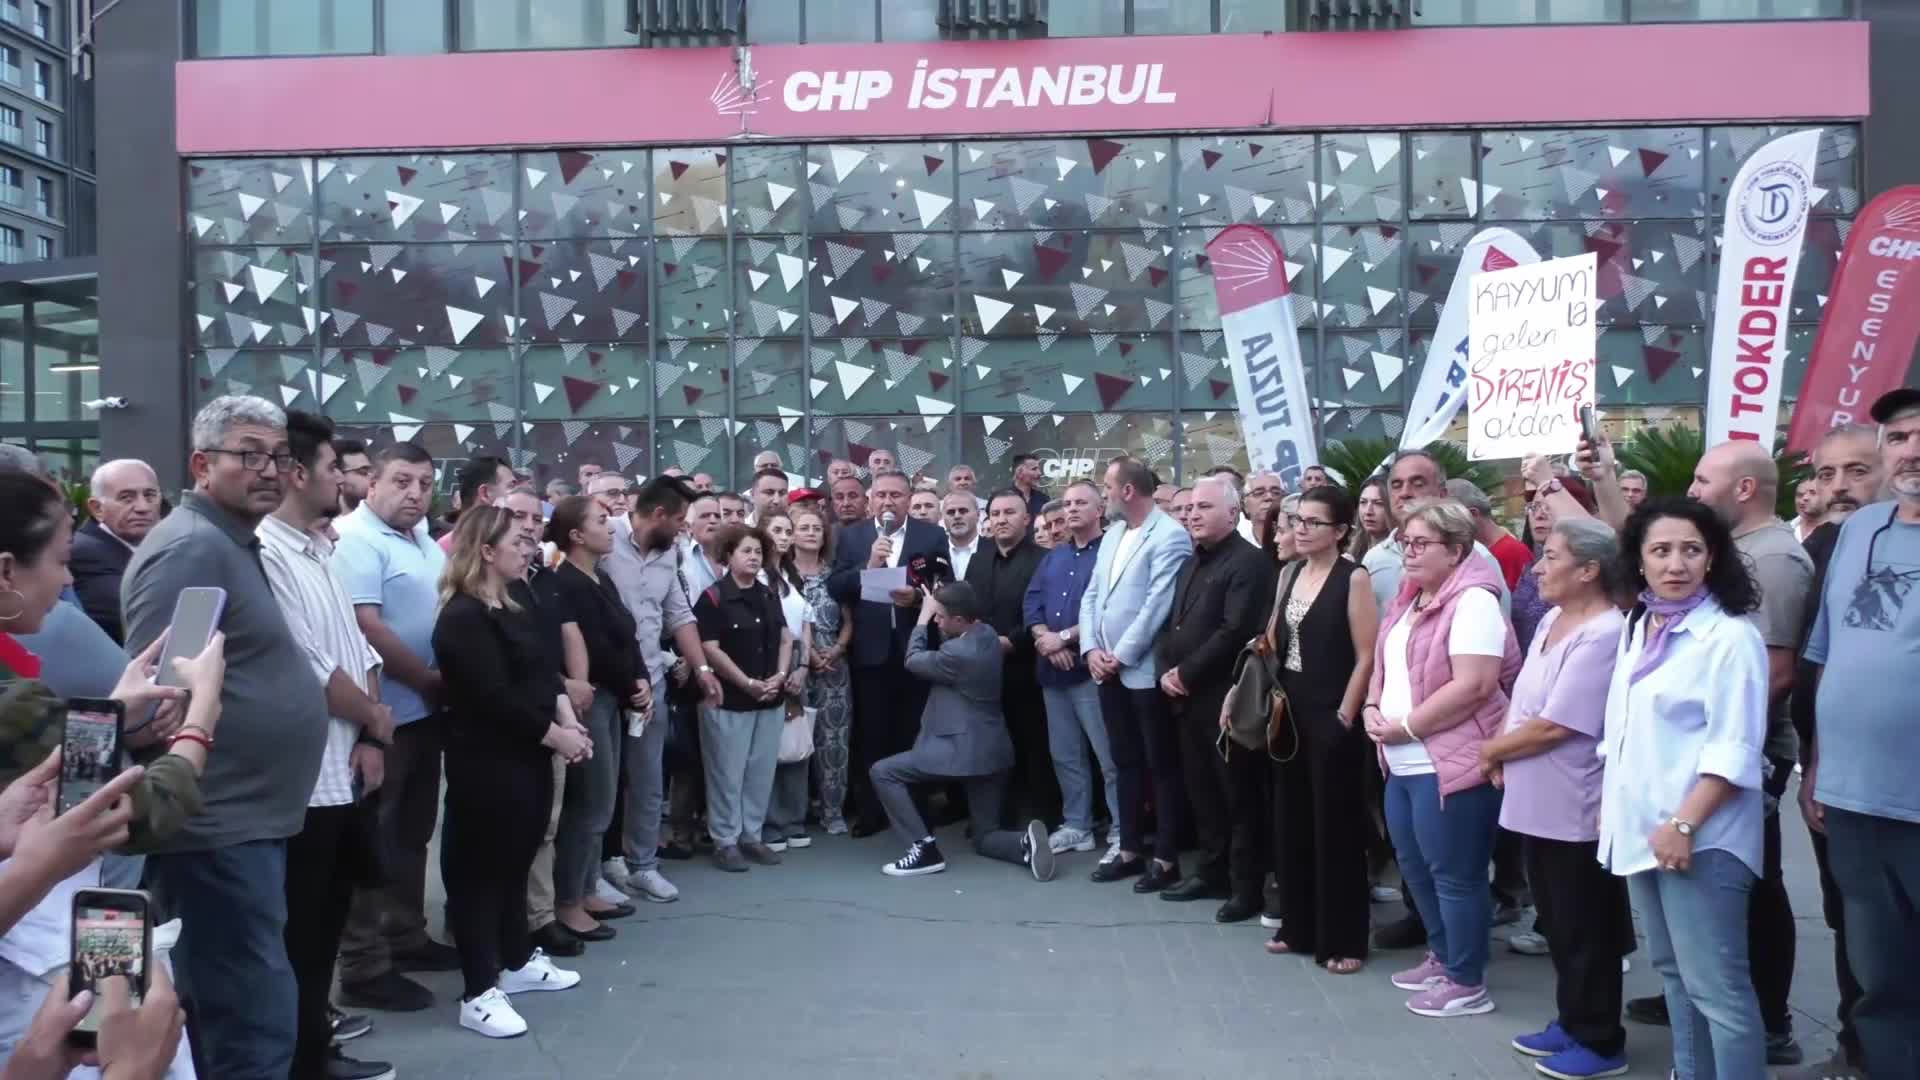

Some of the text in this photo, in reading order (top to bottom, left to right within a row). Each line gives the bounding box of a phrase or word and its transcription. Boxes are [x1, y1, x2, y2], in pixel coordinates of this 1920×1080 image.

[784, 58, 1177, 112] CHP İSTANBUL
[1471, 319, 1557, 374] gelen
[1730, 256, 1788, 418] TOKDER
[1831, 269, 1899, 430] ESENYUR
[1043, 458, 1095, 478] CHP
